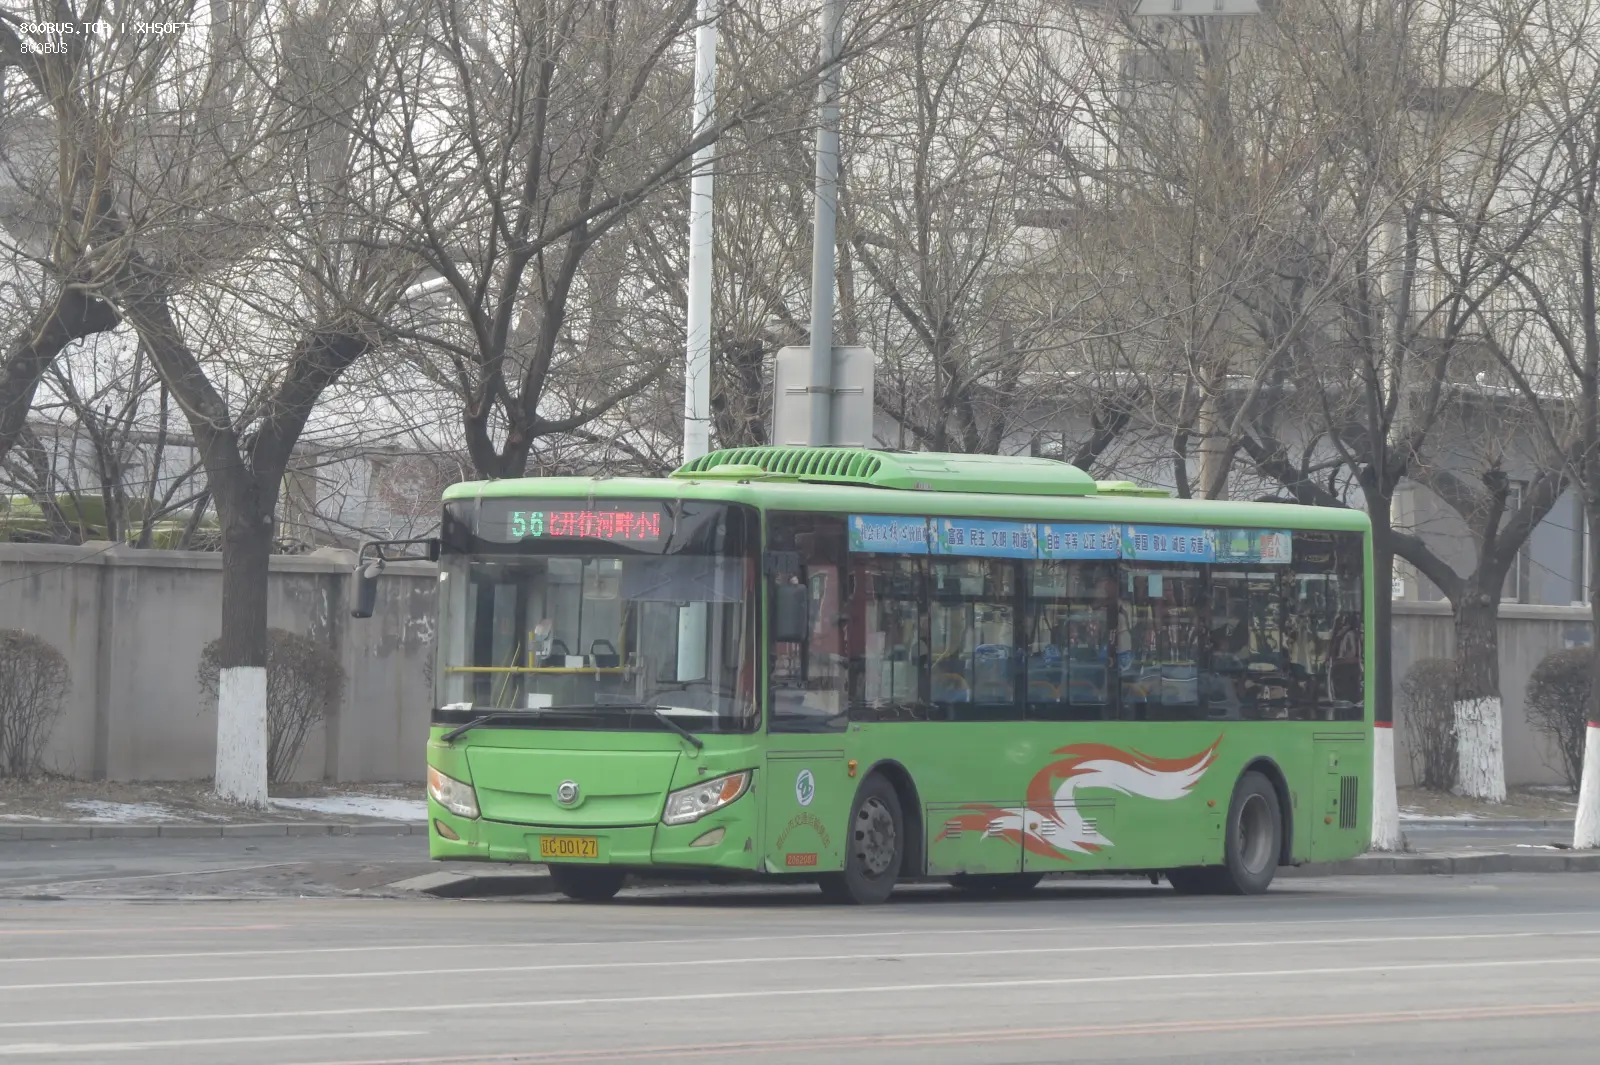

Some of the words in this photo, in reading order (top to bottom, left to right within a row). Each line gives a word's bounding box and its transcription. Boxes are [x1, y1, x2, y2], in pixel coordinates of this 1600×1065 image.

[511, 511, 544, 537] 56
[948, 527, 964, 546] 富强
[970, 529, 986, 547] 民主
[991, 529, 1007, 548] 文明
[1012, 531, 1028, 549] 和谐
[1047, 533, 1060, 550] 自由
[1064, 532, 1078, 550] 平等
[1083, 532, 1096, 550] 公正
[1134, 534, 1149, 551] 爱国
[1153, 535, 1167, 552] 敬业
[1172, 535, 1186, 553] 诚信
[1190, 536, 1204, 554] 友善
